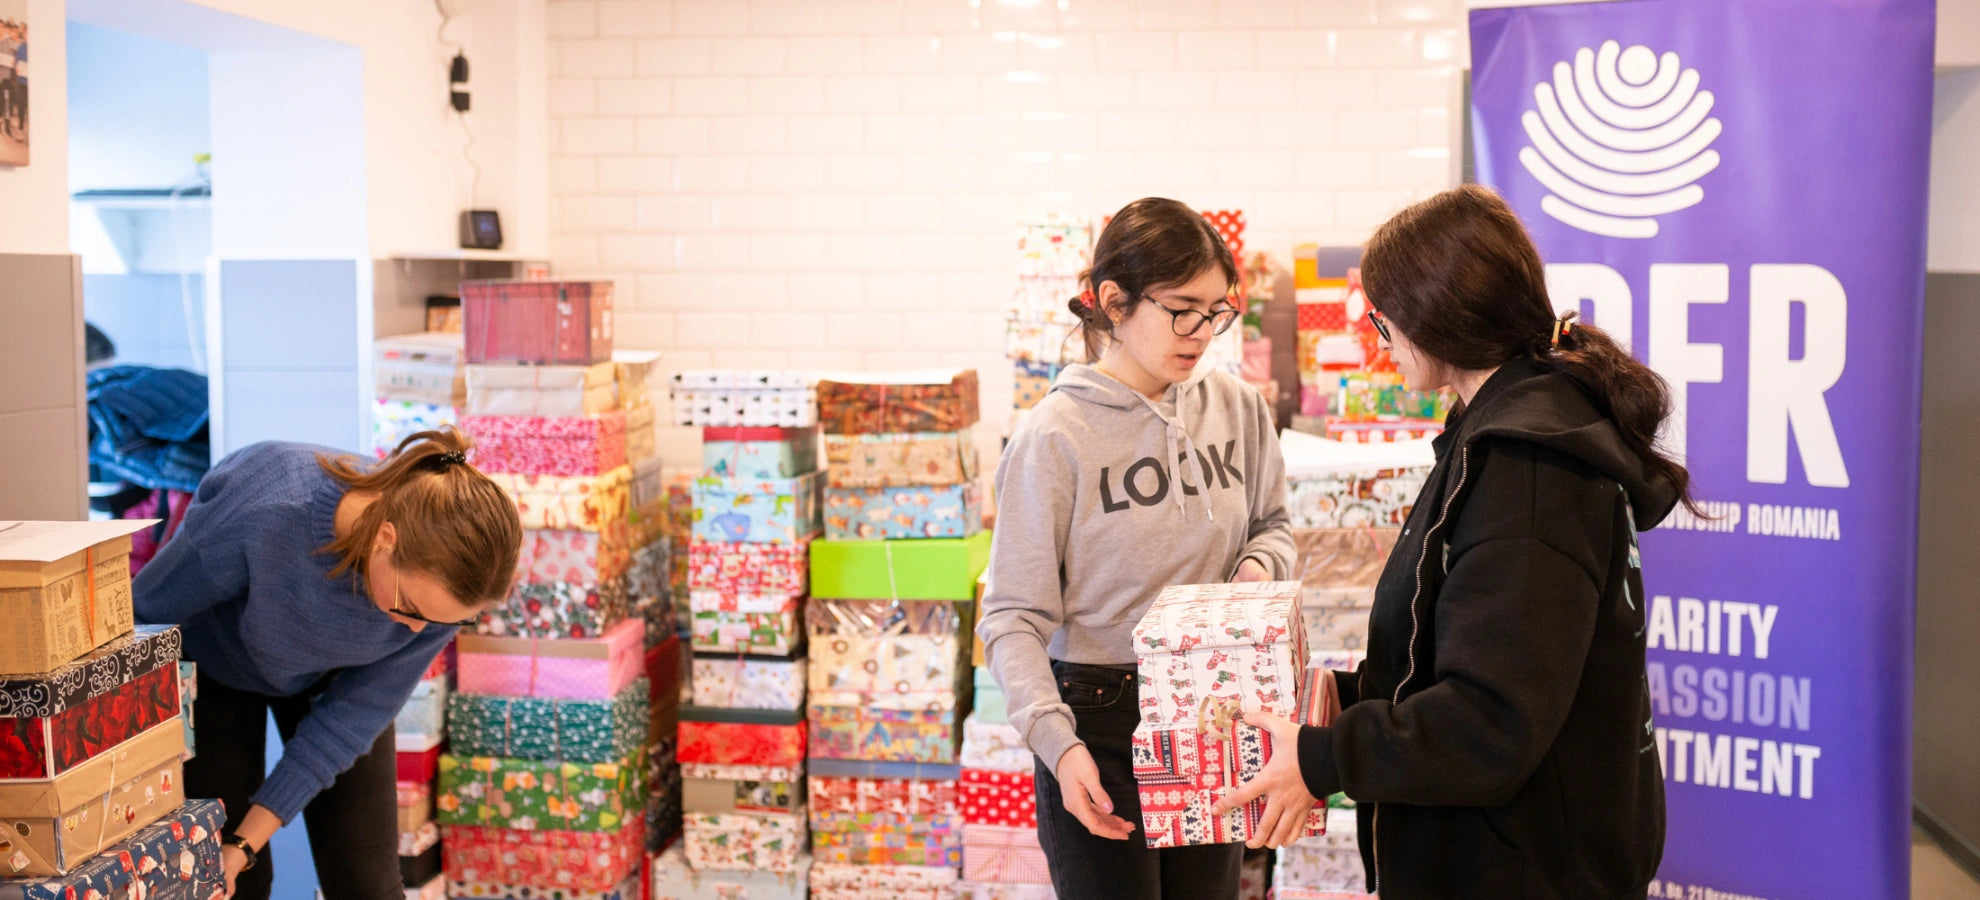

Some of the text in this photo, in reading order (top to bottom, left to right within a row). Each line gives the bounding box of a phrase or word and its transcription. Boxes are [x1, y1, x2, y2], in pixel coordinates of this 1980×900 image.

[1100, 440, 1244, 514] LOOK
[1657, 500, 1840, 541] OWSHIP ROMANIA
[1646, 595, 1778, 659] ARITY
[1647, 661, 1811, 731] ASSION
